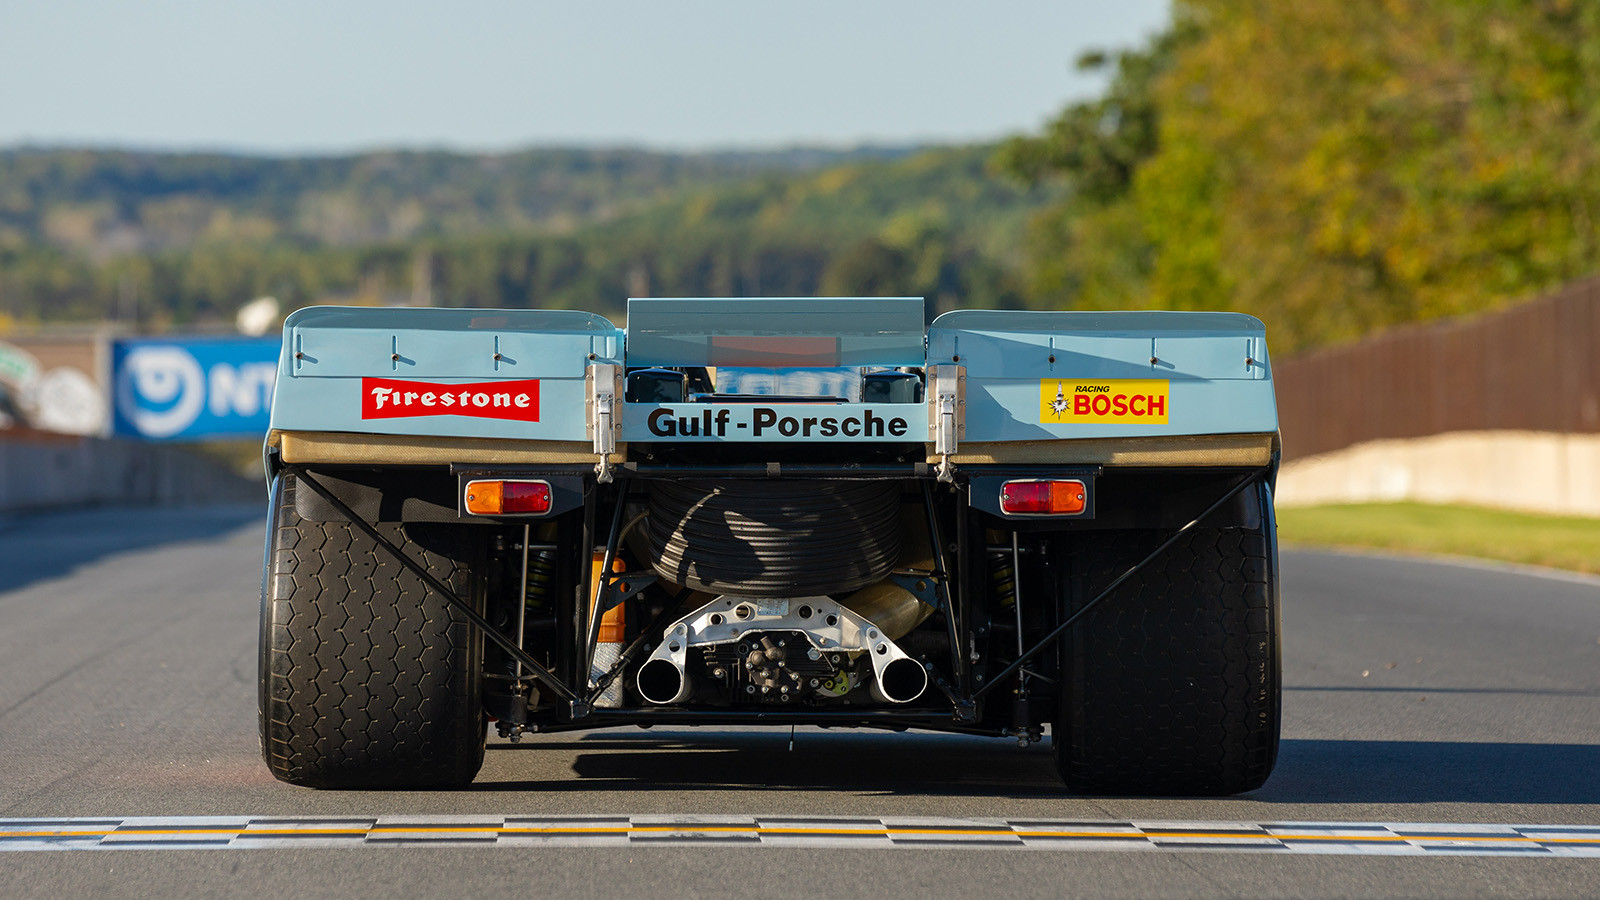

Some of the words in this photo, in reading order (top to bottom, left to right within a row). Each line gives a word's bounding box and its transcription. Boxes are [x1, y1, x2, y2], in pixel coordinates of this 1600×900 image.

[371, 387, 531, 410] Firestone
[1075, 385, 1110, 393] RACING
[1074, 394, 1165, 416] BOSCH
